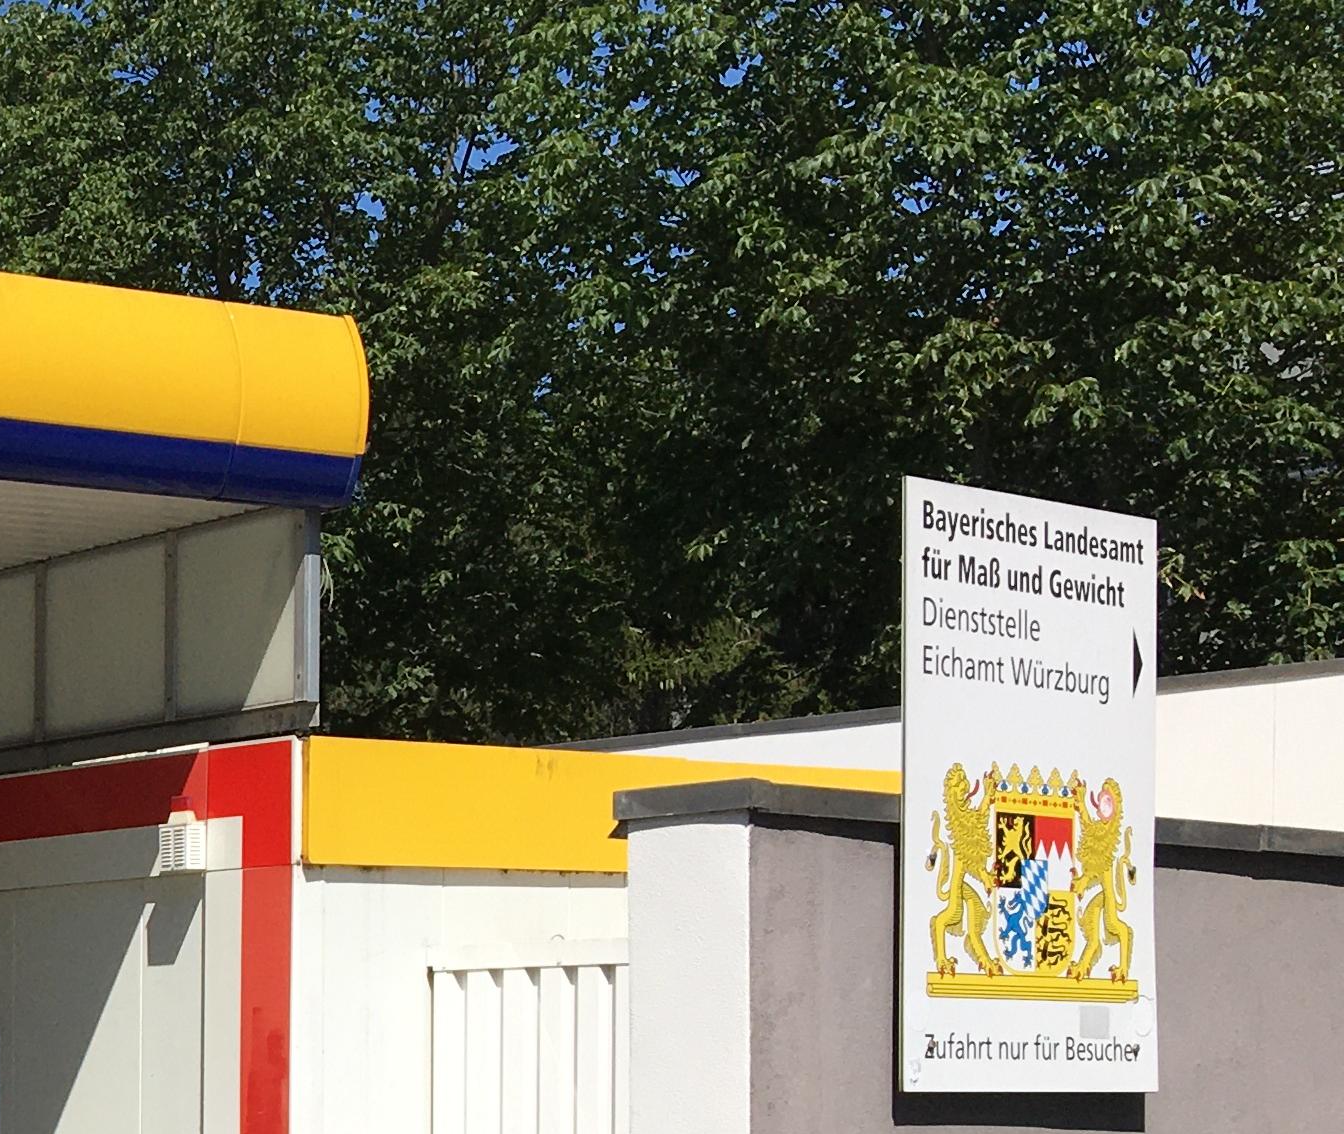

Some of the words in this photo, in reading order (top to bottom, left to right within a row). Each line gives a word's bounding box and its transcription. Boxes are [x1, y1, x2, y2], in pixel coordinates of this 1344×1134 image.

[923, 500, 1037, 547] Bayerisches
[1045, 521, 1144, 565] Landesamt
[922, 547, 951, 580] für
[959, 554, 1000, 589] Maß
[1008, 565, 1043, 595] und
[1050, 569, 1125, 607] Gewicht
[923, 597, 1040, 641] Dienststelle
[923, 645, 1004, 683] Eichamt
[1011, 656, 1109, 704] Würzburg
[924, 1032, 993, 1060] Zufahrt
[999, 1041, 1029, 1061] nur
[1034, 1034, 1060, 1061] für
[1066, 1036, 1140, 1062] Besucher
